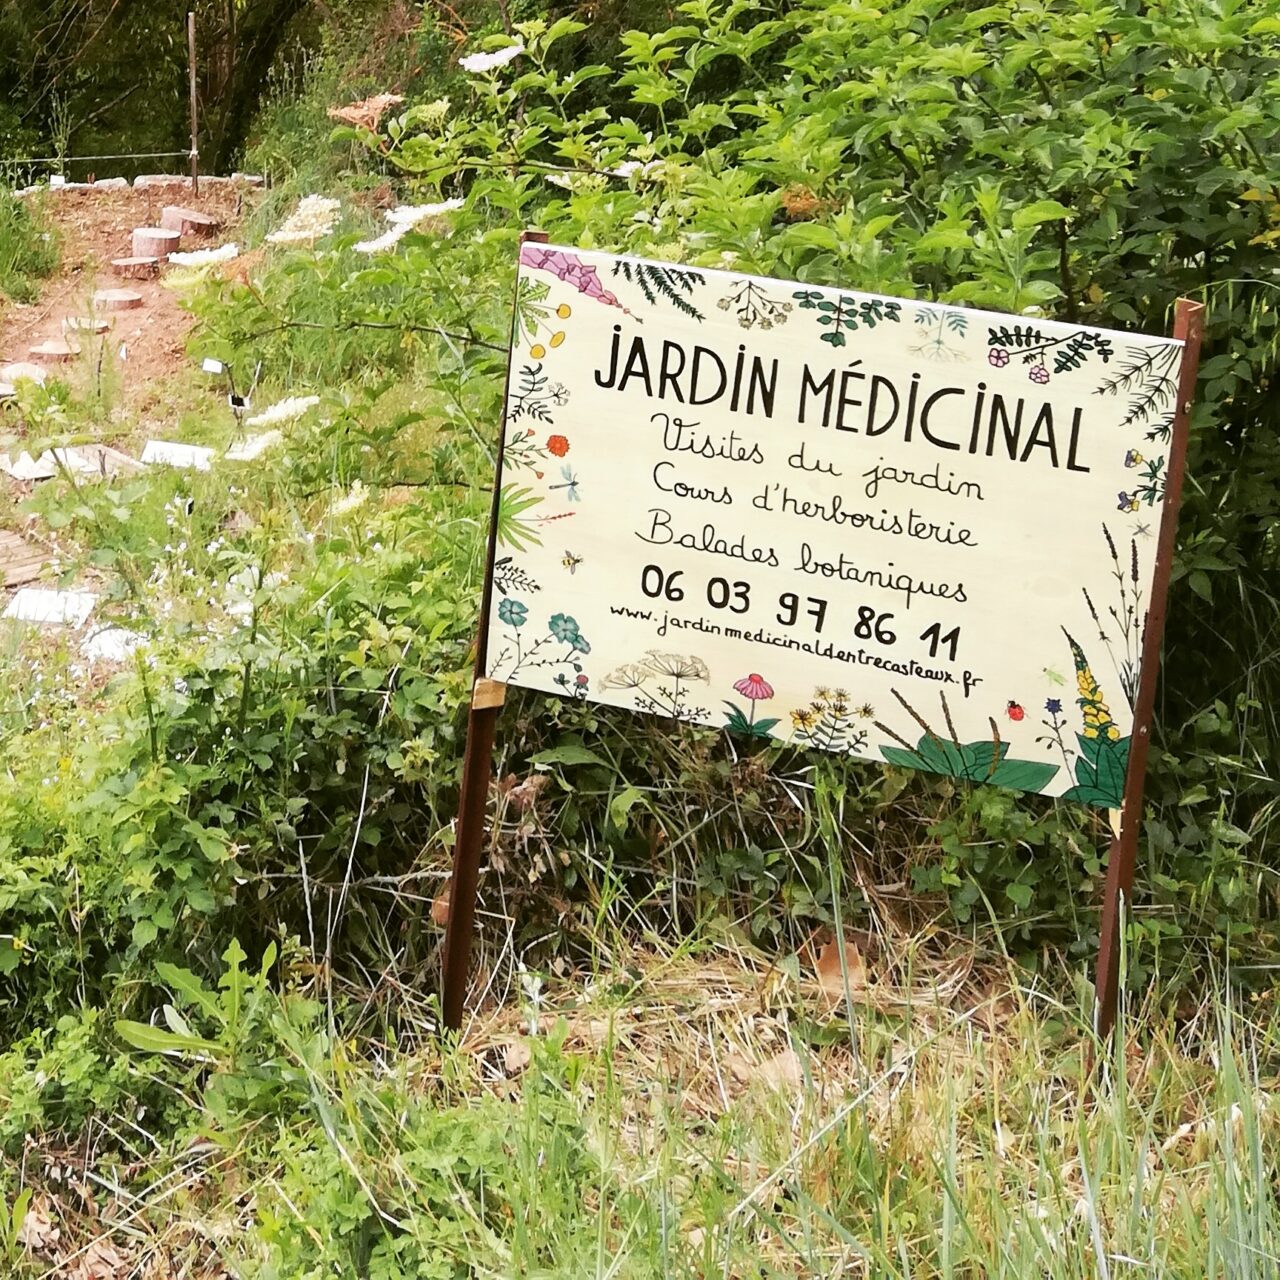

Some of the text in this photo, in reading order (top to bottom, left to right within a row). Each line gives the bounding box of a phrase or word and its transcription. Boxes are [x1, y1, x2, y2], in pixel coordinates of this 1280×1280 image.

[650, 412, 984, 501] Visites du jardin
[653, 461, 978, 547] Cours d'herboristerie
[634, 508, 968, 610] Balades botaniques
[610, 606, 984, 698] www.jardinmedicinaldentrecasteaux.fr
[641, 564, 961, 662] 06 03 97 86 11
